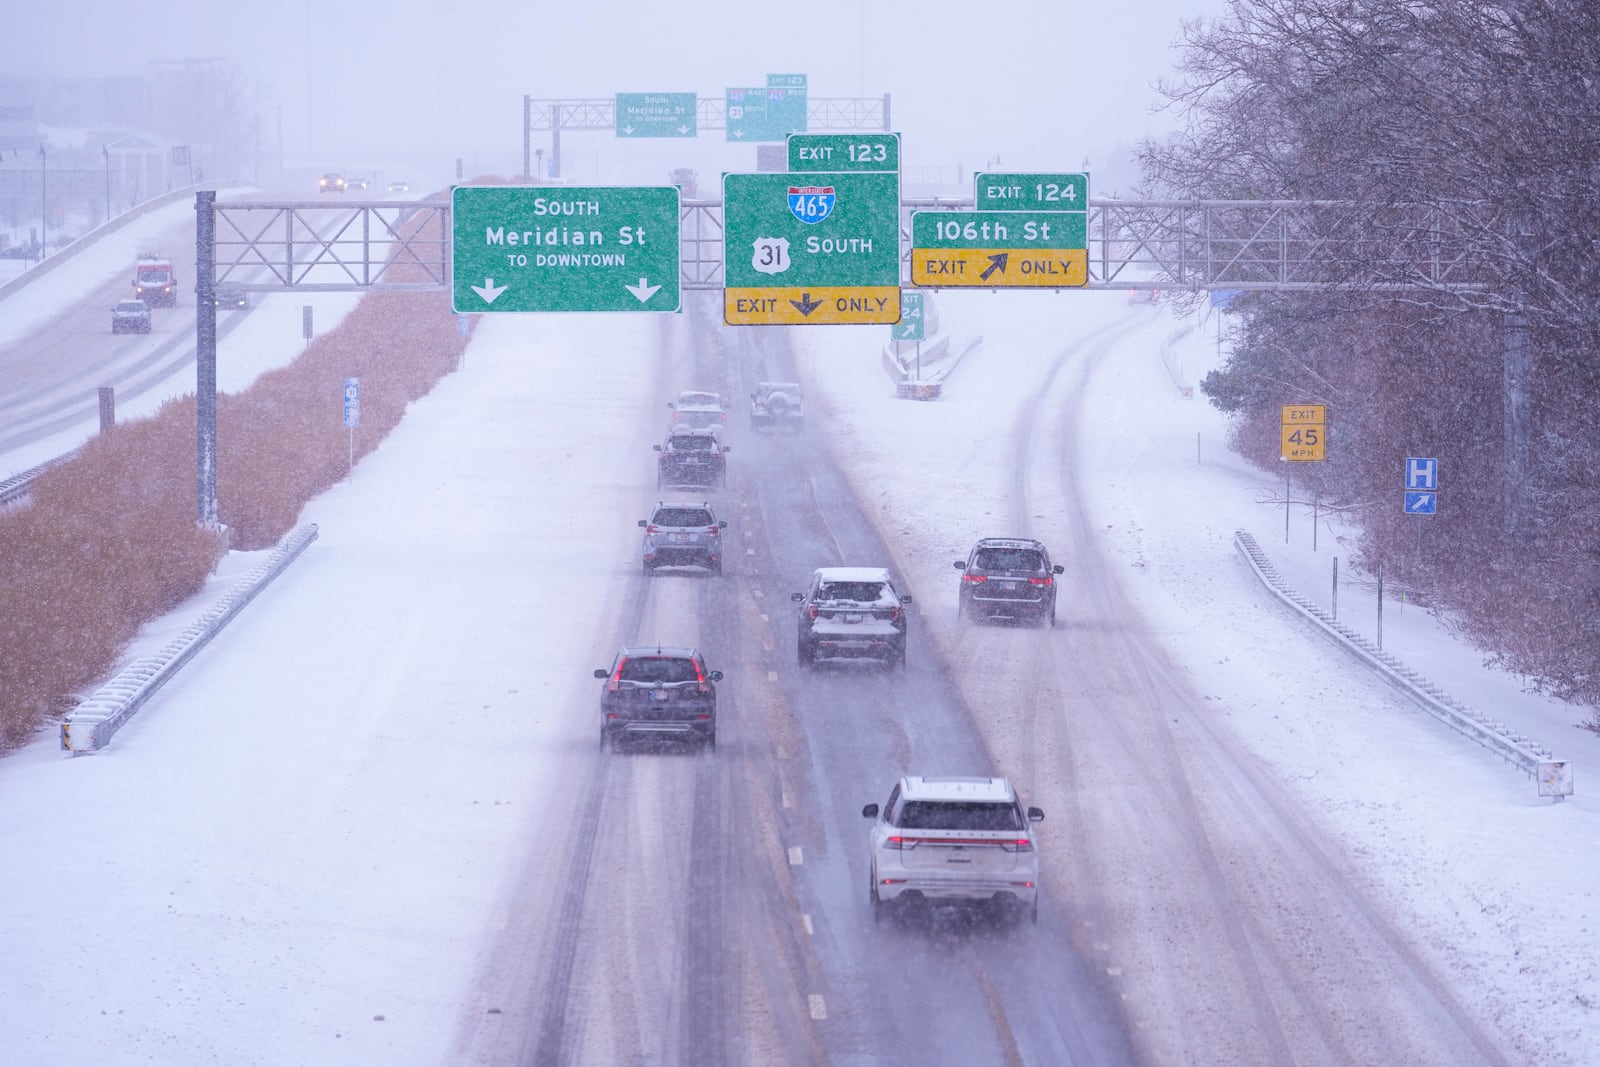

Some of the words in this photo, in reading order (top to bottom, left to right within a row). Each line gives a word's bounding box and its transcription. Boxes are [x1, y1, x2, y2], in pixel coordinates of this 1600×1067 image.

[627, 106, 670, 114] Meridian
[731, 108, 741, 116] 31
[799, 147, 833, 160] EXIT
[849, 144, 887, 162] 123
[987, 186, 1021, 198] EXIT
[1036, 183, 1076, 202] 124
[533, 198, 600, 216] SOUTH
[795, 195, 828, 217] 465
[486, 226, 603, 245] Meridian
[618, 226, 646, 245] St
[936, 221, 1007, 240] 106th
[1023, 221, 1050, 240] St
[760, 244, 781, 266] 31
[806, 235, 873, 254] SOUTH
[508, 254, 527, 267] TO
[536, 254, 625, 267] DOWNTOWN
[926, 260, 967, 274] EXIT
[1020, 260, 1072, 275] ONLY
[737, 298, 777, 313] EXIT
[836, 297, 888, 312] ONLY
[902, 295, 919, 304] XIT
[902, 307, 921, 319] 24
[1291, 410, 1316, 420] EXIT
[1287, 429, 1318, 446] 45
[1409, 460, 1433, 488] H
